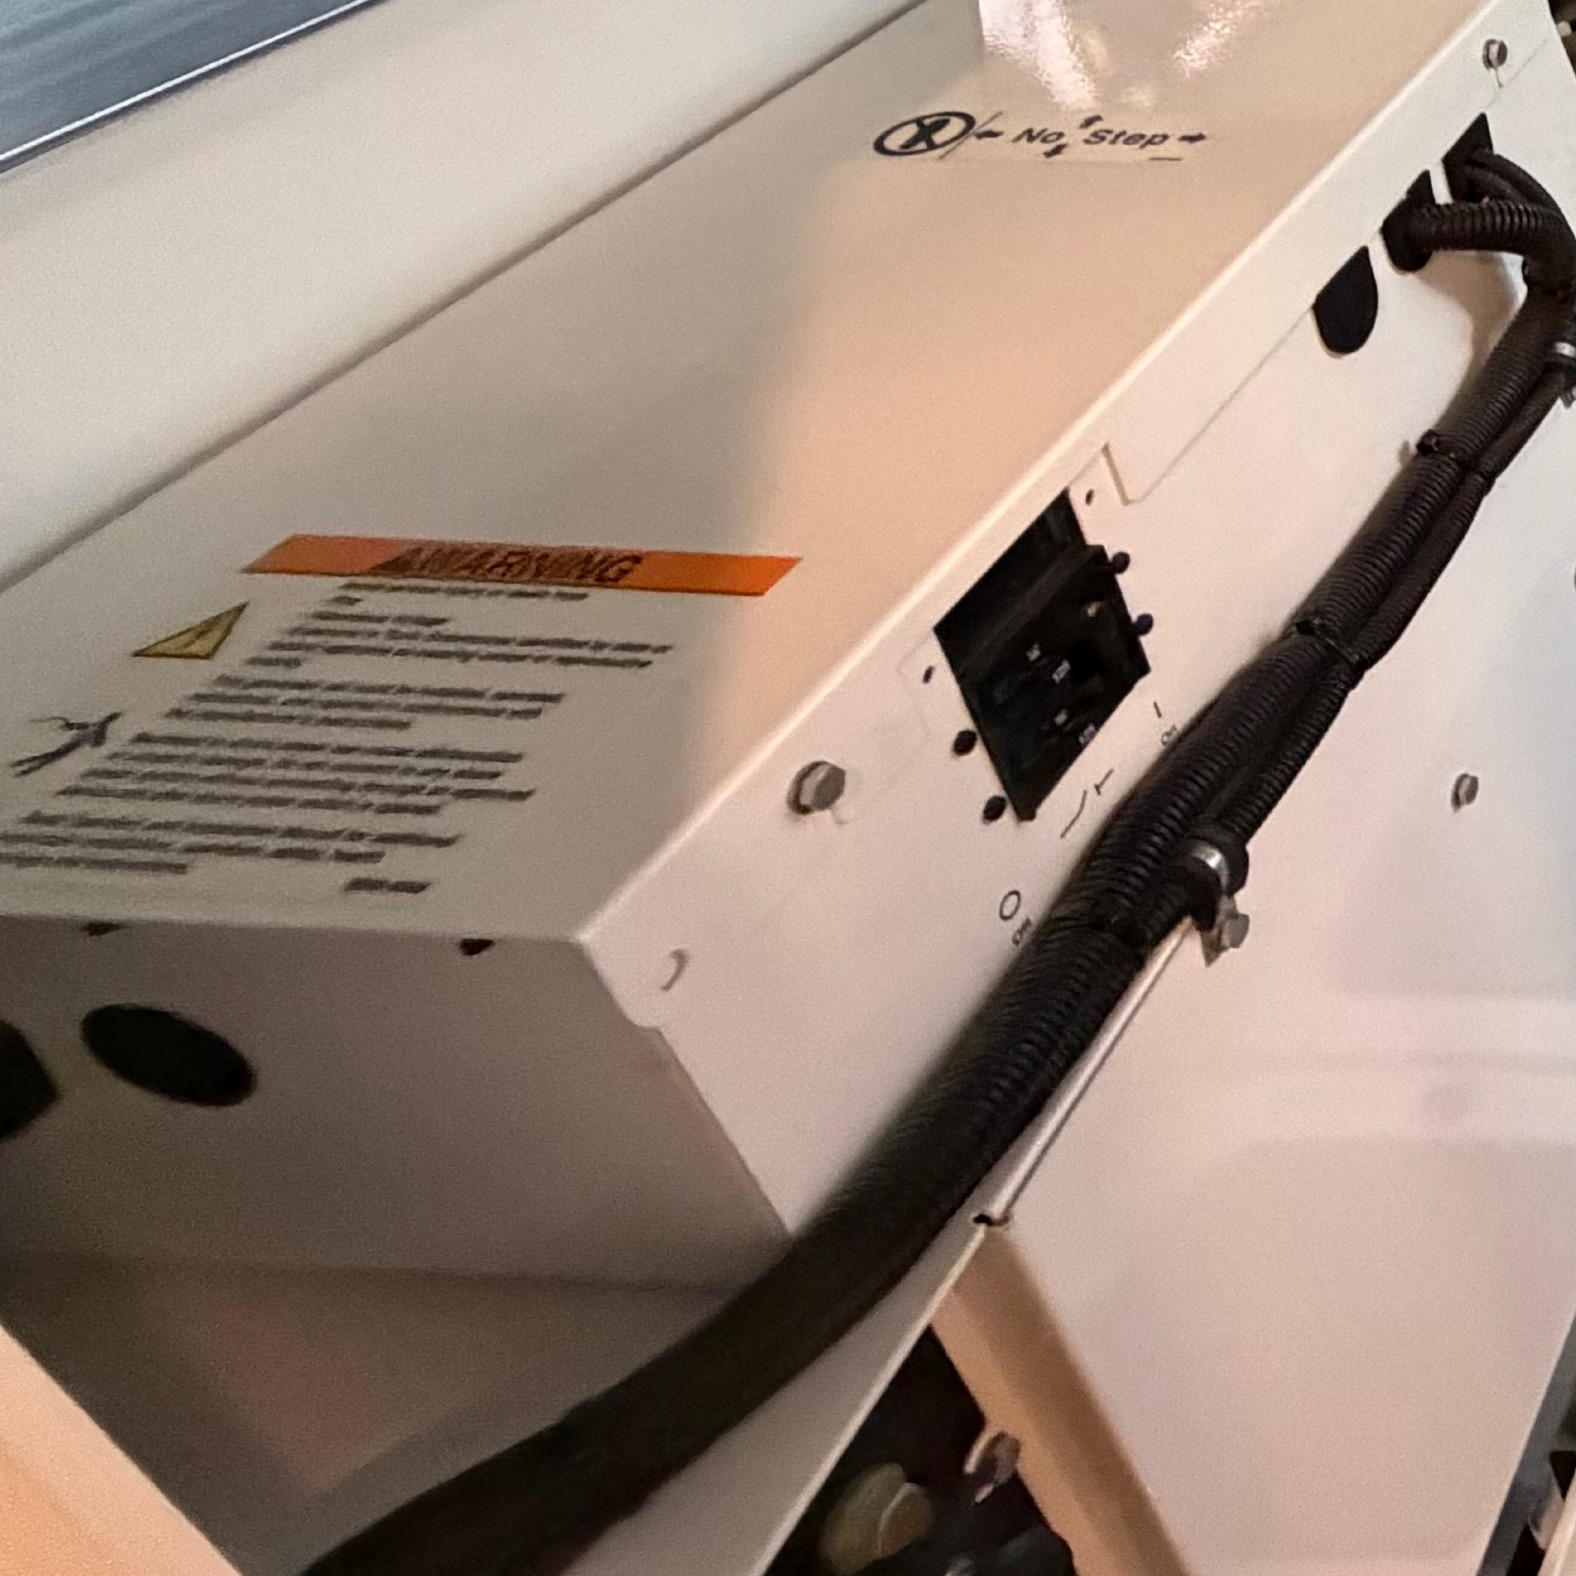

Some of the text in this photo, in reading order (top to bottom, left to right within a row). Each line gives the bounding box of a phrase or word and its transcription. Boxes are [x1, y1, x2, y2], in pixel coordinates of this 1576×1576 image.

[1012, 127, 1170, 149] No Step
[398, 545, 643, 584] WARNING
